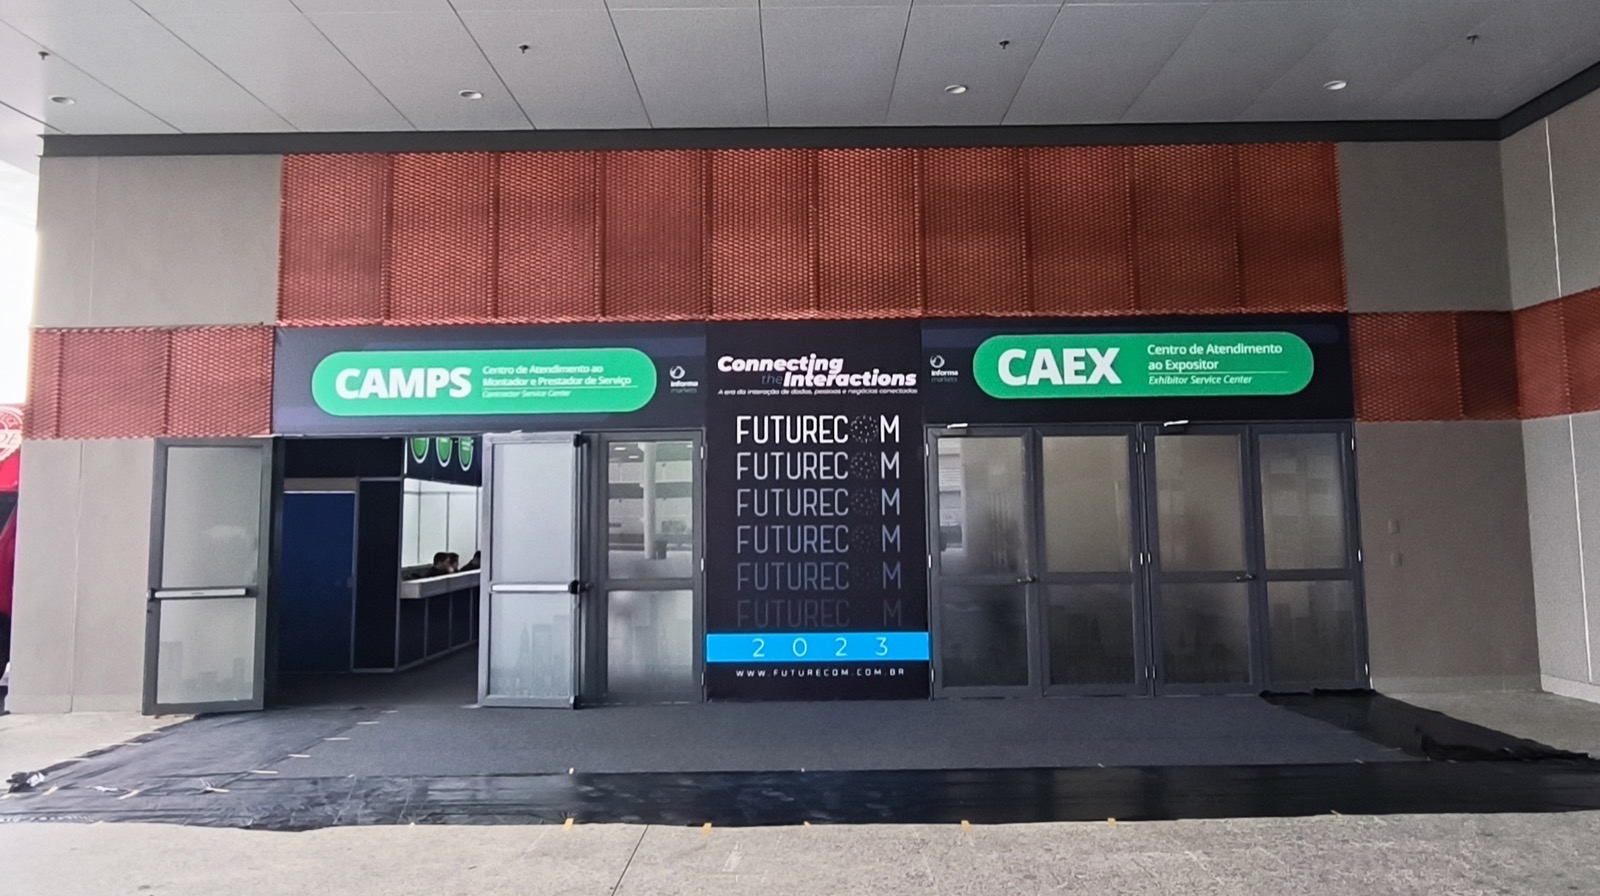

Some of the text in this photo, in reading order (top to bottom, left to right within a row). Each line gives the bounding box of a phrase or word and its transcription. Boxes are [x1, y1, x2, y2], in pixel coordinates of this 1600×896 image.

[1147, 343, 1283, 355] Centro de Atendimento
[482, 364, 604, 375] Centro de Atendimento ao
[717, 353, 844, 374] Connecting
[998, 347, 1122, 386] CAEX
[1148, 359, 1219, 373] ao Expositor
[335, 367, 472, 399] CAMPS
[482, 377, 529, 386] Montador
[538, 377, 583, 386] Prestador
[584, 376, 597, 385] de
[598, 375, 632, 387] Serviço
[761, 369, 917, 387] the Interactions
[1149, 374, 1252, 385] Exhibitor Service Center
[521, 389, 547, 397] Service
[737, 561, 902, 591] FUTURECM
[737, 599, 902, 628] FUTURECM
[735, 668, 905, 677] WWW.FUTURECOM.COM.BR
